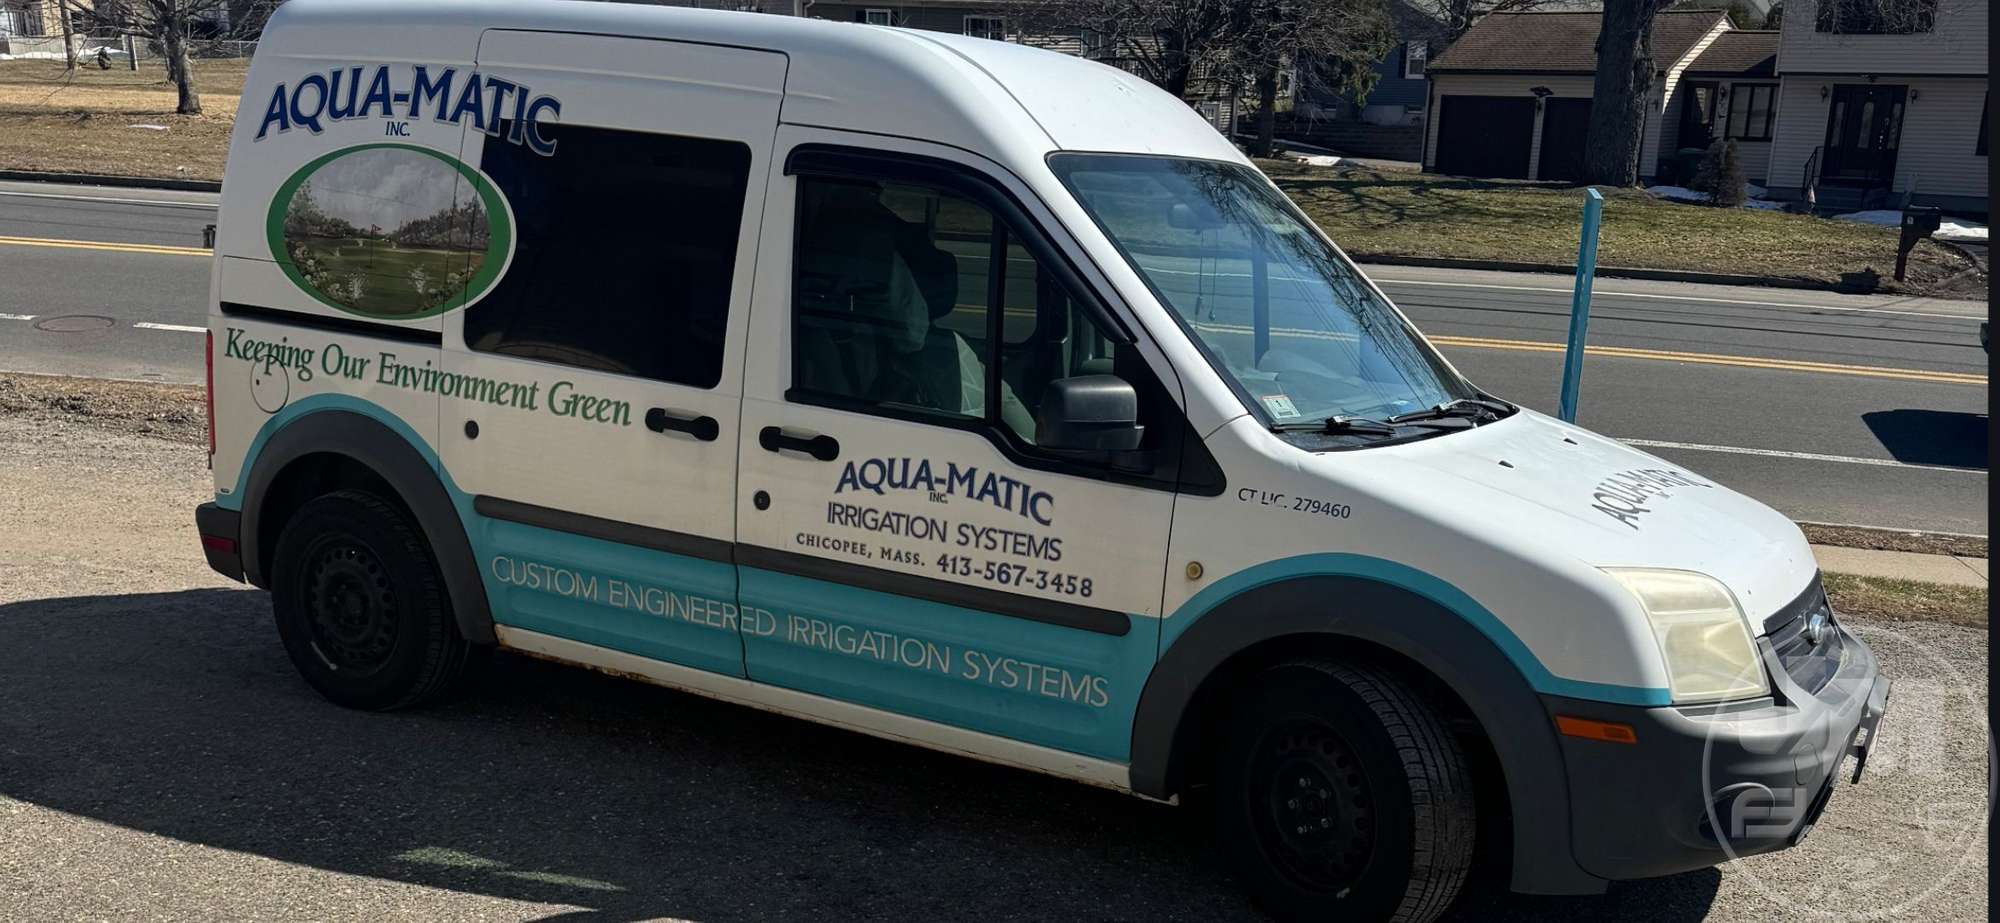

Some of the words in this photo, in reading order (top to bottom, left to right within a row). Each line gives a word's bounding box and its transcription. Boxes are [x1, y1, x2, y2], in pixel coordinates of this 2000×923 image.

[254, 64, 561, 157] AQUA-MATIC
[385, 121, 411, 137] INC.
[224, 327, 314, 381] Keeping
[321, 342, 371, 380] Our
[376, 352, 538, 411] Environment
[548, 381, 632, 426] Green
[834, 457, 1055, 527] AQUA-MATIC
[1293, 497, 1351, 519] 279460
[796, 532, 872, 559] CHICOPEE,
[880, 547, 925, 566] MASS.
[937, 553, 1093, 598] 413-567-3458
[827, 501, 948, 543] IRRIGATION
[956, 523, 1062, 563] SYSTEMS
[491, 555, 598, 601] CUSTOM
[608, 580, 776, 636] ENGINEERED
[788, 614, 950, 674] IRRIGATION
[962, 650, 1109, 708] SYSTEMS
